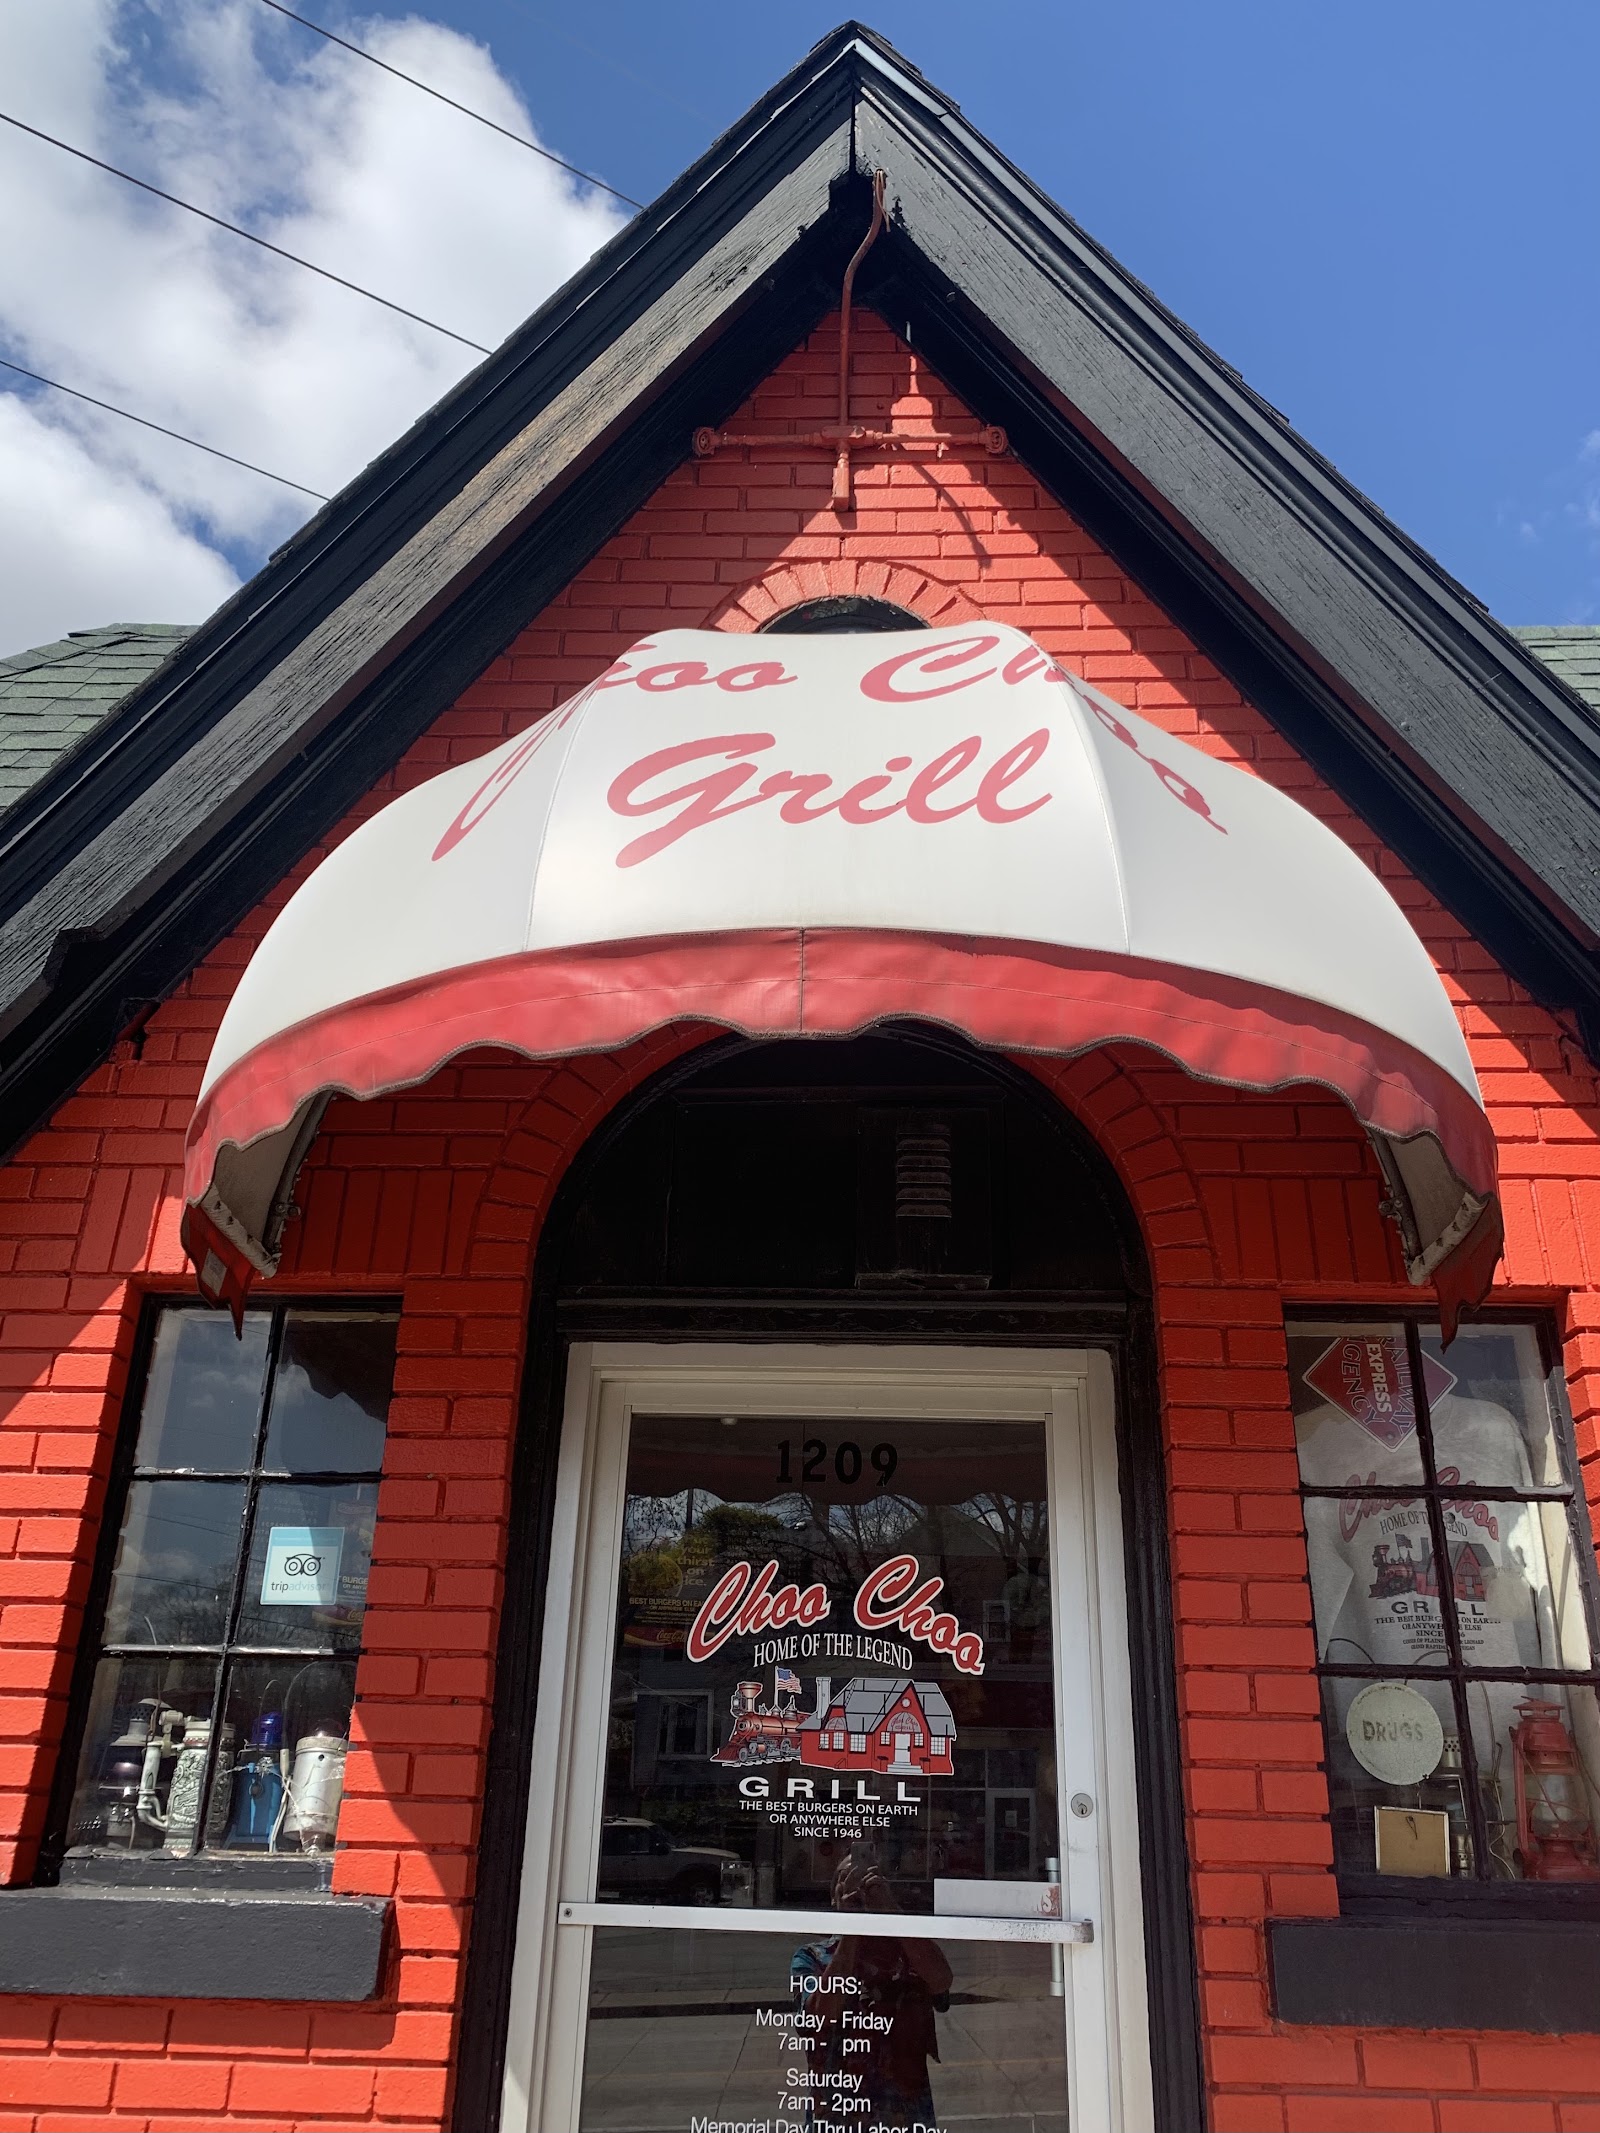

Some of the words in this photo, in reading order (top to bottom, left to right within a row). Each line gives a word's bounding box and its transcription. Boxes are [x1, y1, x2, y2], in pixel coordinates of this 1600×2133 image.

[607, 727, 1053, 869] Grill
[1341, 1336, 1386, 1425] GENCY
[1366, 1343, 1393, 1413] EXPRESS
[776, 1438, 898, 1487] 1209
[1339, 1471, 1417, 1543] Ch
[1380, 1511, 1408, 1535] HOME
[1408, 1510, 1420, 1525] OF
[1445, 1521, 1468, 1537] GEND
[678, 1556, 715, 1566] thirst
[271, 1581, 327, 1594] tripadvisor
[342, 1575, 368, 1585] BURGE
[629, 1597, 647, 1605] BEST
[648, 1598, 682, 1607] BURGERS
[1391, 1600, 1484, 1615] GRLL
[687, 1559, 831, 1662] Choo
[853, 1554, 985, 1675] Choo
[1374, 1617, 1395, 1625] THE
[1397, 1615, 1414, 1623] BEST
[1411, 1623, 1463, 1631] ANYWHE
[1416, 1630, 1444, 1638] SINCE
[1424, 1637, 1446, 1645] PLAINF
[753, 1635, 798, 1667] HOME
[801, 1633, 821, 1657] OF
[823, 1632, 853, 1657] THE
[856, 1635, 913, 1671] LEGEND
[1362, 1719, 1424, 1742] DRUGS
[739, 1776, 921, 1802] GRILL
[739, 1800, 763, 1811] THE
[765, 1801, 795, 1812] BEST
[797, 1802, 853, 1814] BURGERS
[855, 1804, 875, 1815] ON
[878, 1805, 918, 1816] EARTH
[769, 1813, 787, 1824] OR
[790, 1815, 859, 1826] ANYWHERE
[862, 1816, 891, 1827] ELSE
[794, 1827, 829, 1838] SINCE
[833, 1828, 862, 1839] 1946
[789, 1975, 862, 1995] HOURS:
[755, 2009, 825, 2032] Monday
[842, 2011, 894, 2034] Friday
[777, 2032, 815, 2051] 7am
[842, 2038, 871, 2056] pm
[786, 2067, 863, 2093] Saturday
[777, 2091, 815, 2110] 7am
[831, 2093, 871, 2116] 2pm
[690, 2116, 770, 2133] Memorial
[776, 2119, 809, 2133] Day
[813, 2120, 852, 2133] Thru
[858, 2121, 908, 2133] Labor
[912, 2123, 947, 2133] Da
